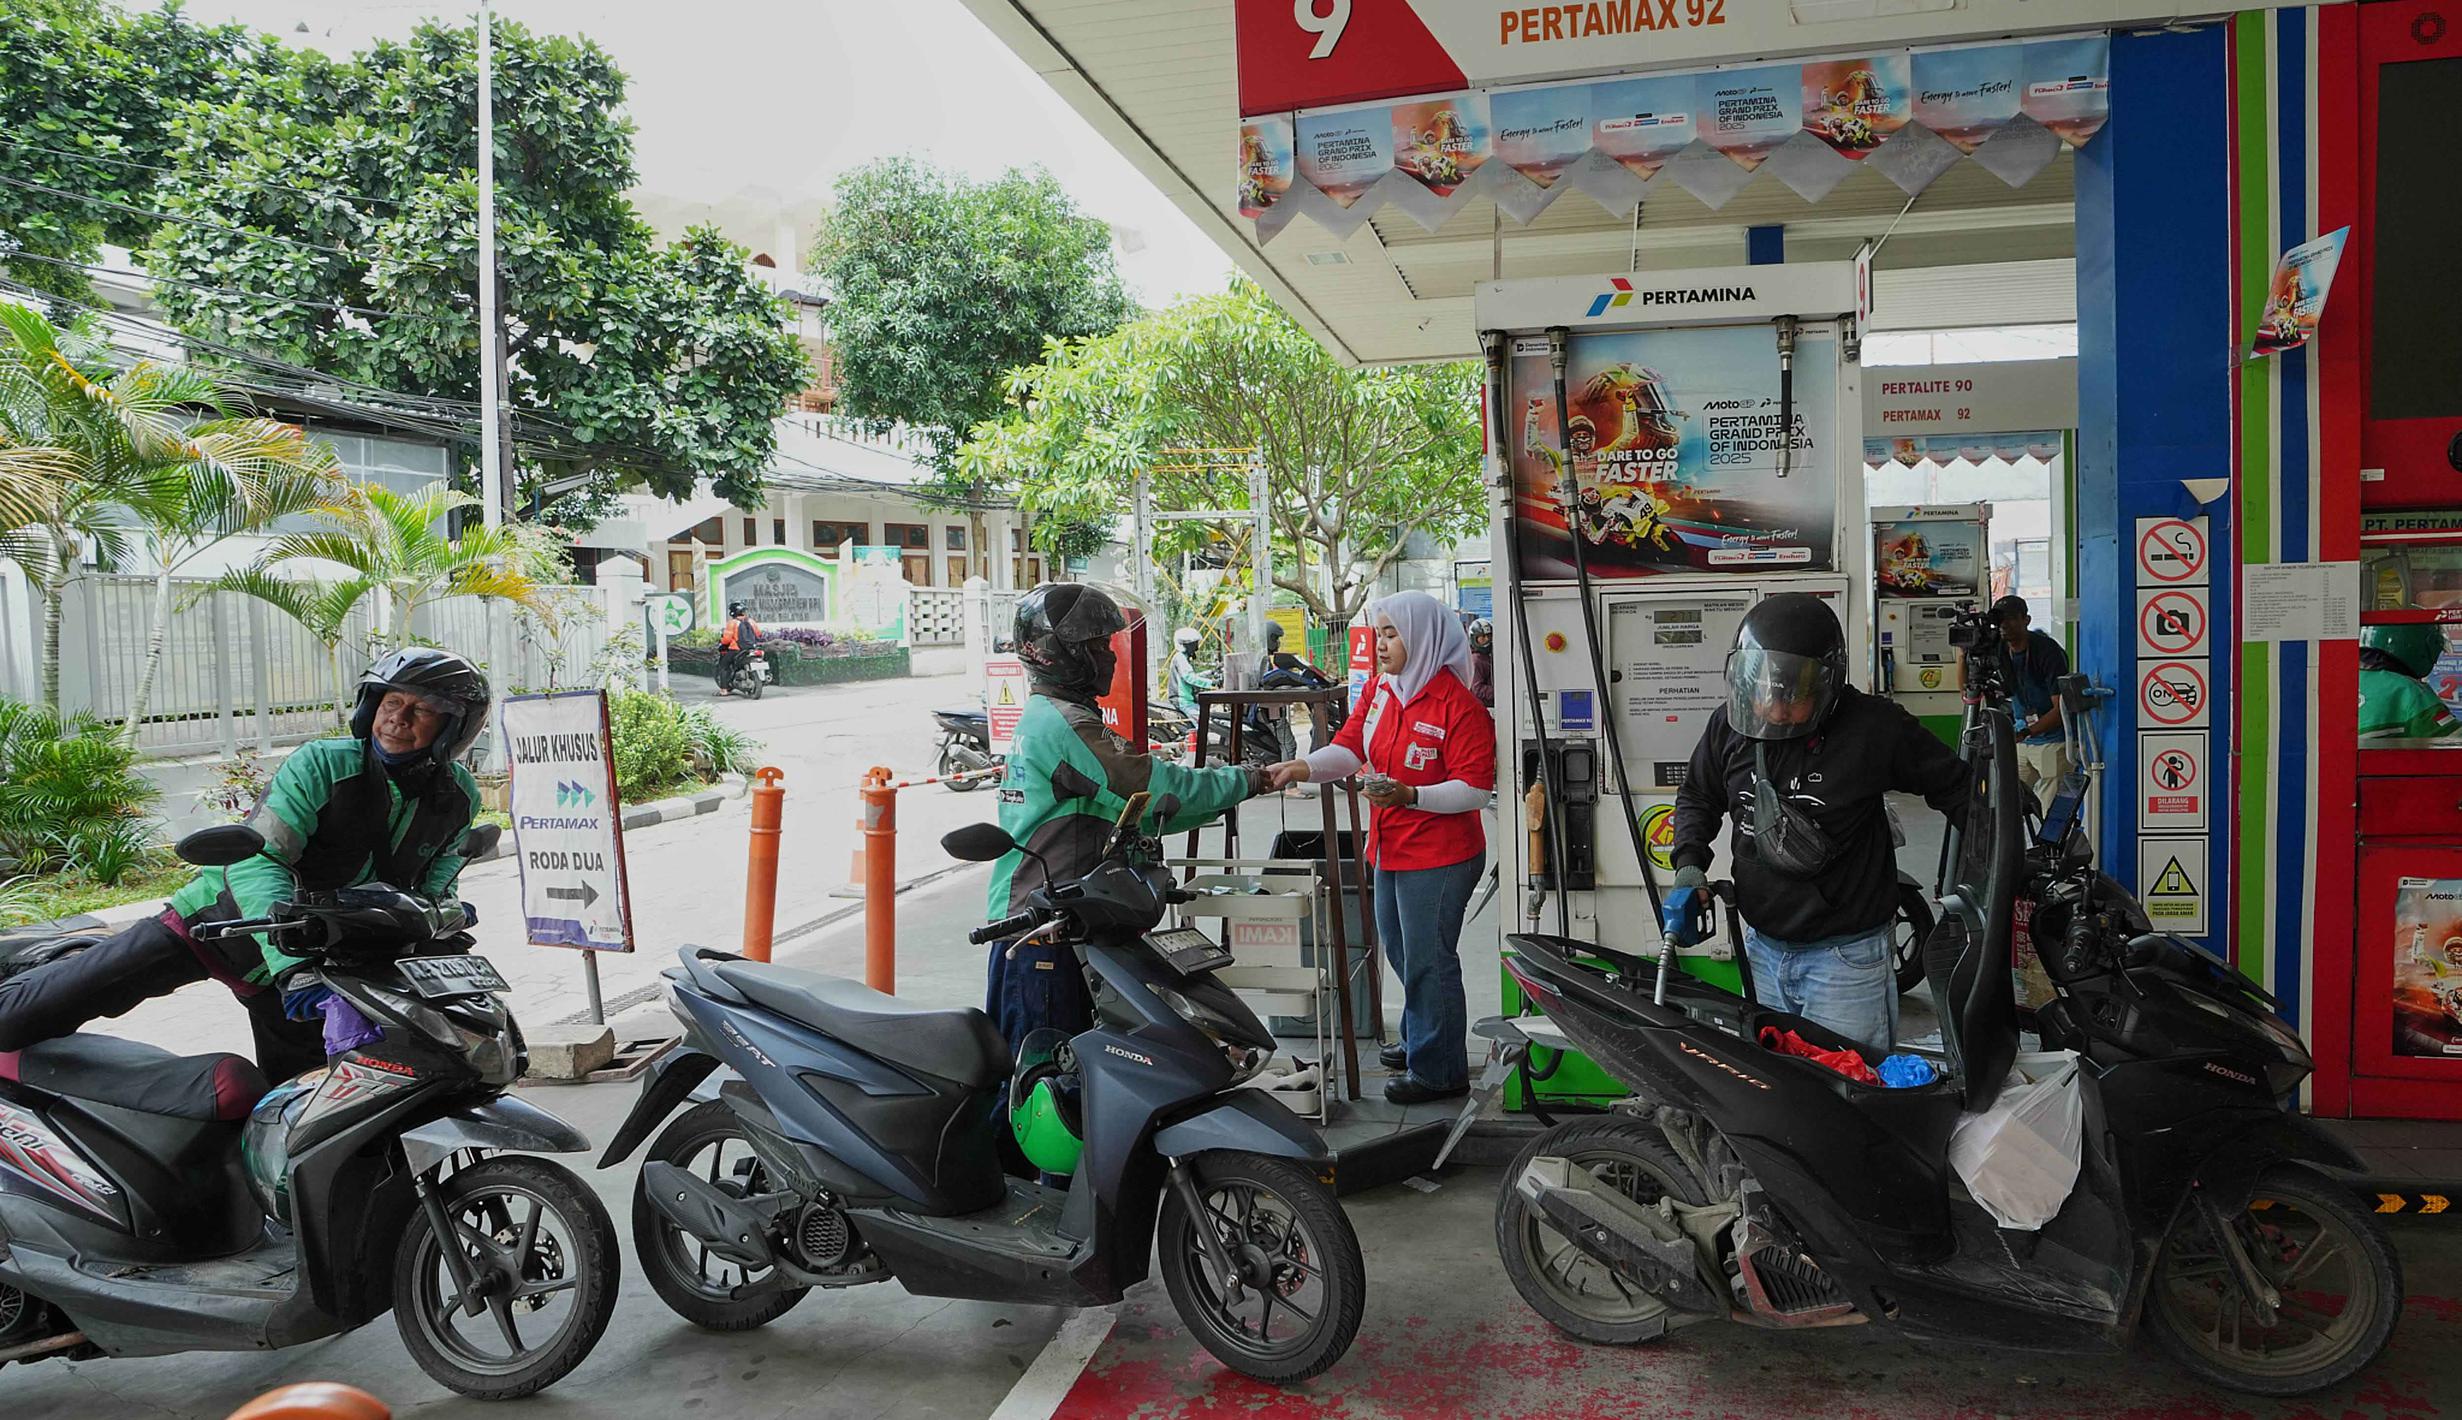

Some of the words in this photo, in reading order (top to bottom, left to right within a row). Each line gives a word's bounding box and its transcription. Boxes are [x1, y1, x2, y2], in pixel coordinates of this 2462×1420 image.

[1501, 0, 1678, 45] PERTAMAX
[1686, 0, 1726, 27] 92
[1293, 0, 1352, 60] 9
[1718, 96, 1777, 108] PERTAMINA
[1920, 91, 1952, 104] Energy
[1718, 106, 1752, 116] GRAND
[1753, 104, 1779, 113] PRIX
[1854, 104, 1890, 115] FASTER
[1718, 115, 1732, 123] OF
[1733, 111, 1784, 122] INDONESIA
[1317, 136, 1371, 149] PERTAMINA
[1441, 141, 1473, 152] FASTER
[1318, 147, 1349, 157] GRAND
[1349, 144, 1372, 154] PRIX
[1318, 156, 1331, 164] OF
[1331, 151, 1377, 163] INDONESIA
[1248, 165, 1280, 177] FASTER
[1642, 287, 1756, 306] PERTAMINA
[1859, 262, 1866, 321] 9
[1882, 380, 1951, 394] PERTALITE
[1955, 379, 1973, 392] 90
[1709, 414, 1804, 428] PERTAMIA
[1883, 409, 1941, 422] PERTAMAX
[1957, 408, 1971, 420] 92
[1710, 429, 1763, 440] GRAND
[1710, 442, 1730, 452] OF
[1733, 438, 1814, 452] INDONSIA
[1597, 450, 1633, 462] DARE
[1636, 449, 1653, 461] TO
[1656, 448, 1679, 460] GO
[1710, 453, 1752, 465] 2025
[1595, 461, 1679, 483] FASTER
[1639, 502, 1654, 521] 49
[516, 736, 550, 765] JALUR
[551, 732, 599, 762] KHUSUS
[520, 816, 599, 830] PERTAMAX
[530, 851, 569, 870] RODA
[573, 851, 605, 871] DUA
[1104, 1044, 1153, 1066] HONDA
[355, 1055, 415, 1077] HONDA
[2203, 1061, 2256, 1086] HONDA
